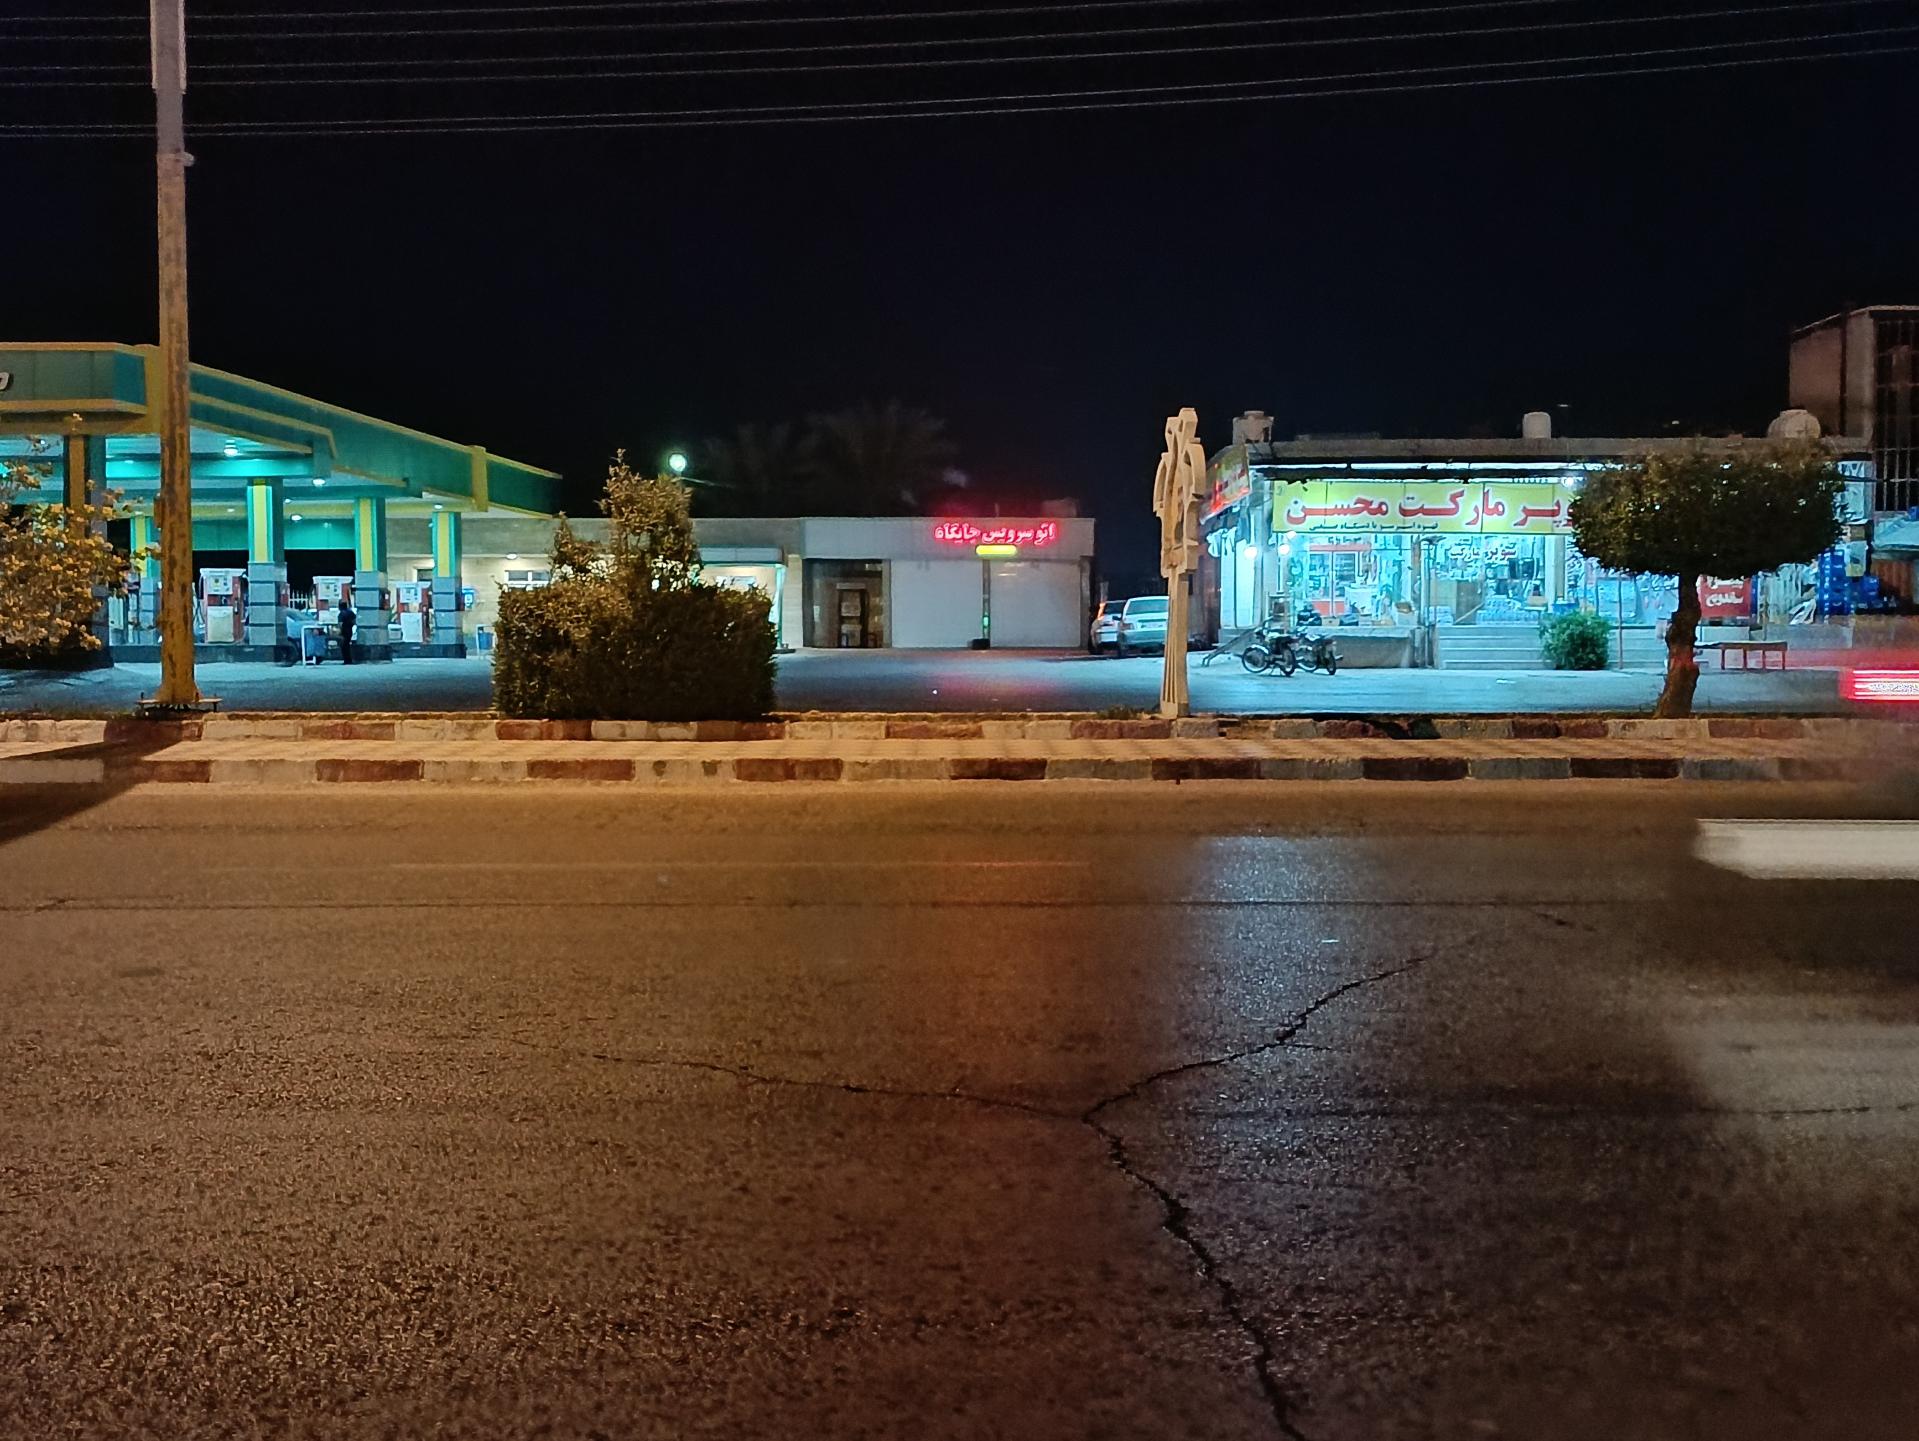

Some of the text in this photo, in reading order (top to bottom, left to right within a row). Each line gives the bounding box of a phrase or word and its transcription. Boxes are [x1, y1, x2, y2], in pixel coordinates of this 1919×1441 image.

[1286, 495, 1389, 523] محسن
[1397, 490, 1506, 526] مارکت
[934, 522, 981, 543] جایگاه
